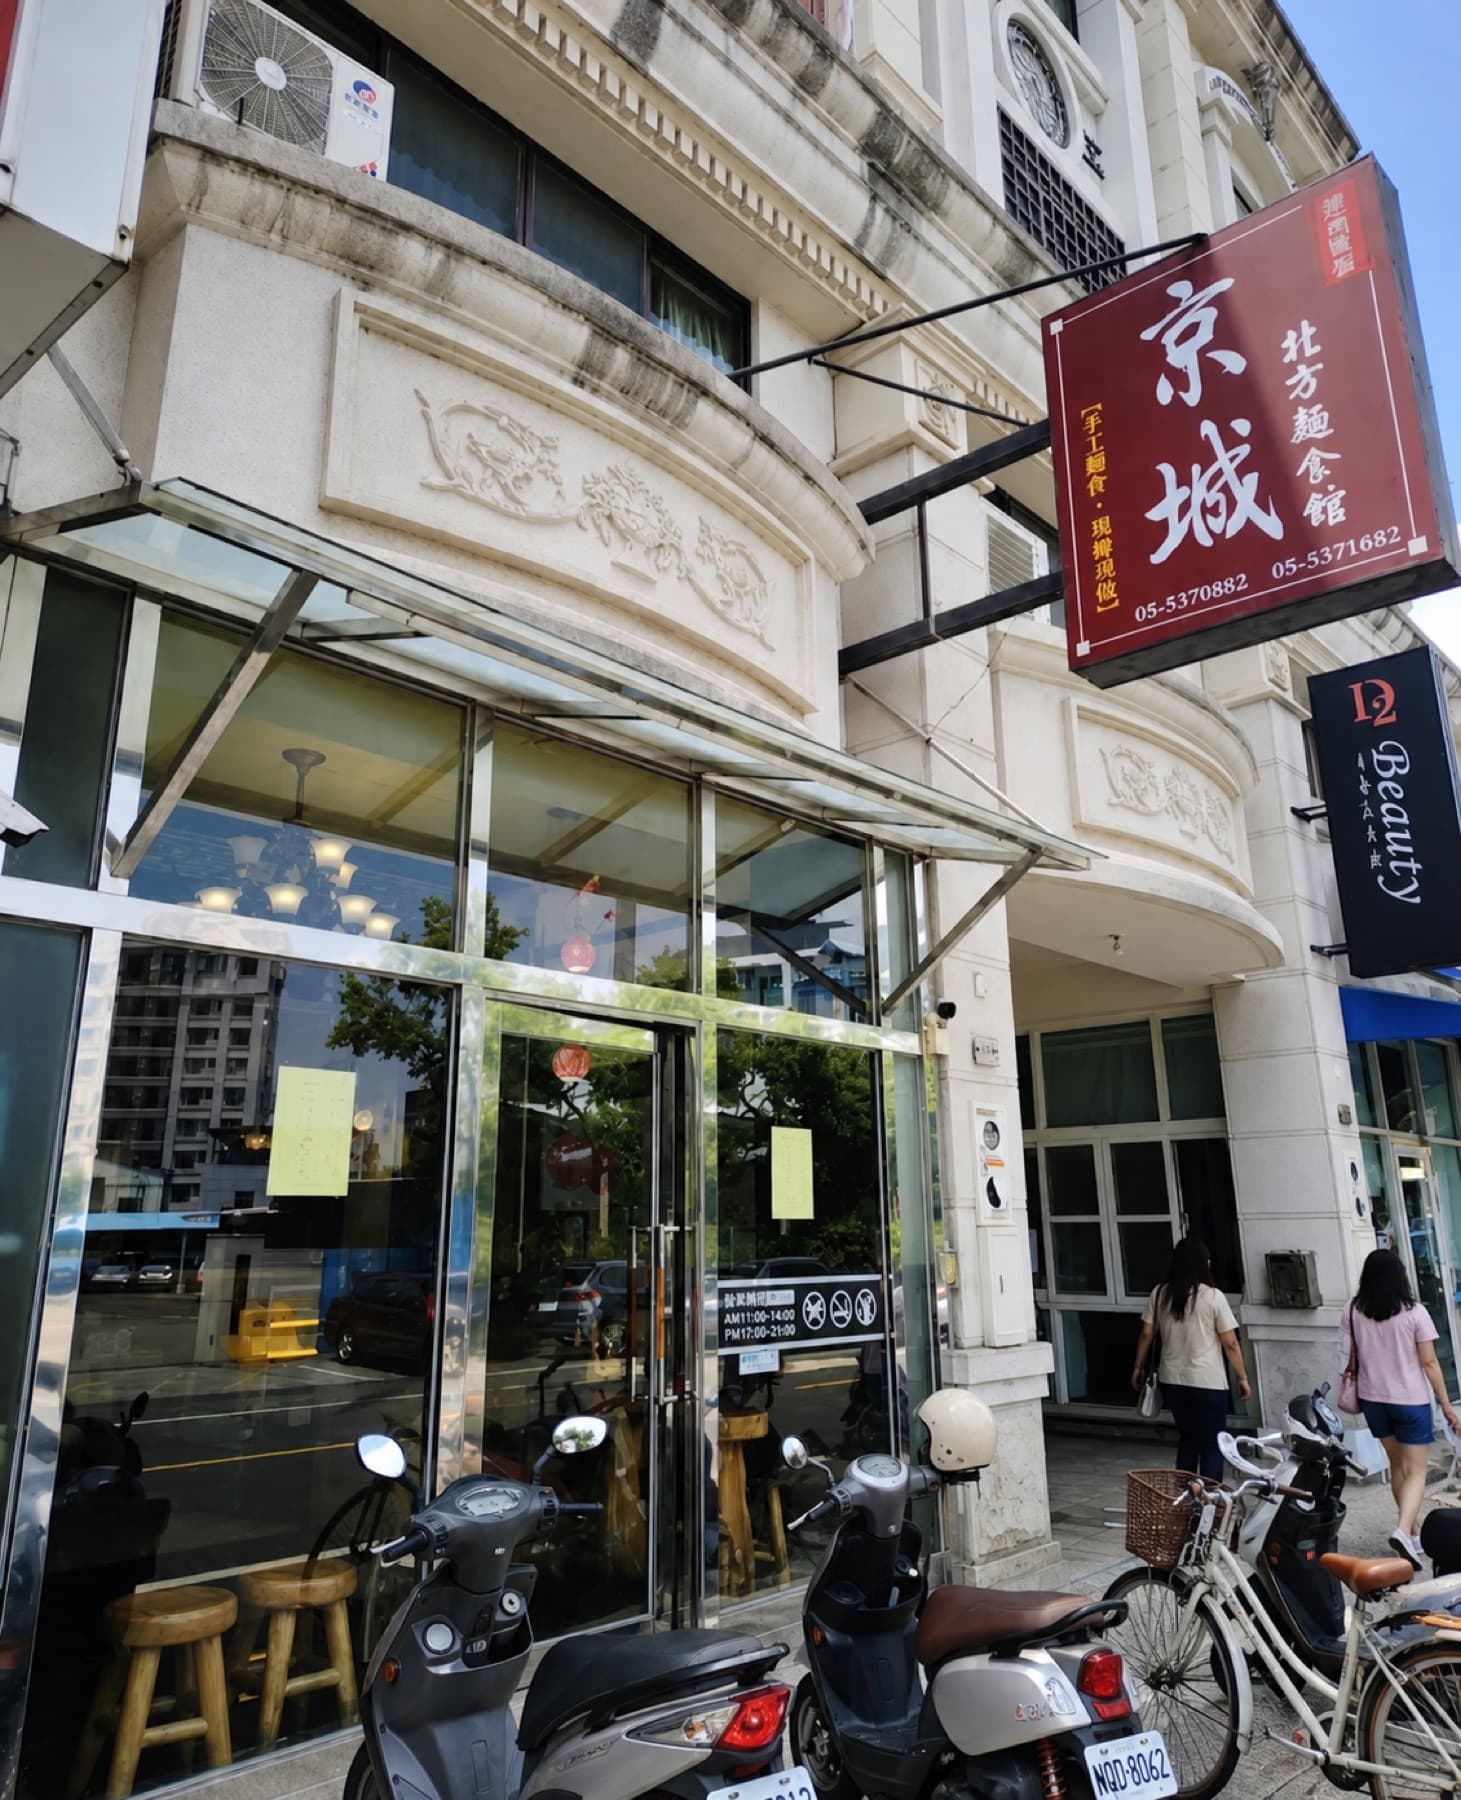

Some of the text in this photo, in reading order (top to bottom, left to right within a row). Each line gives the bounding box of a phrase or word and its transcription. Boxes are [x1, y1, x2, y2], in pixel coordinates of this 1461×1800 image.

[1139, 277, 1284, 565] 京城
[1280, 319, 1346, 528] 北方麵食館
[1134, 572, 1248, 622] 05-5370882
[1270, 524, 1401, 580] 05-5371682
[1371, 740, 1423, 904] Beauty
